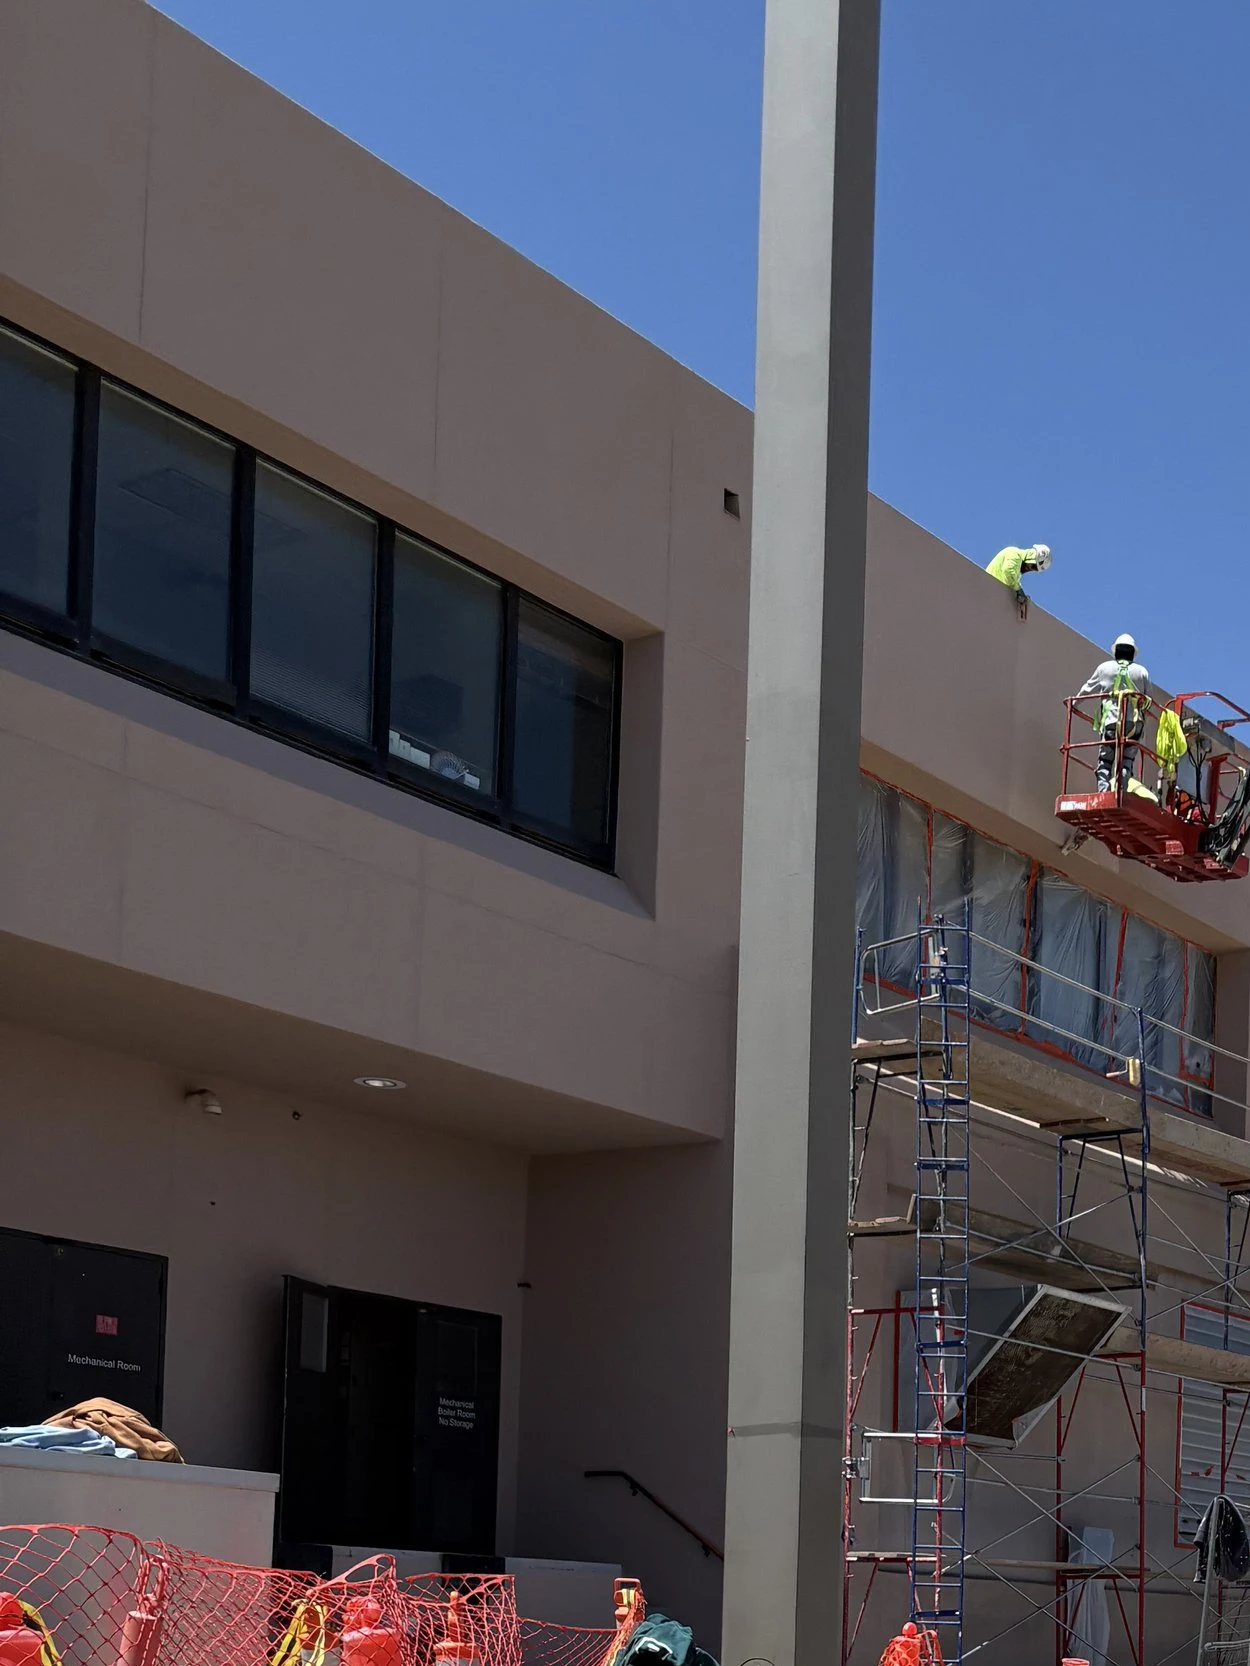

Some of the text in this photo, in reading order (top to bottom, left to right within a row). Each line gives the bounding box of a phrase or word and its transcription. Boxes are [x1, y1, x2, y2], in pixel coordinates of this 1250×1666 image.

[68, 1353, 141, 1372] Mechanical Room
[440, 1397, 474, 1409] Mechanical
[457, 1410, 476, 1419] Room
[439, 1417, 473, 1429] No Storage
